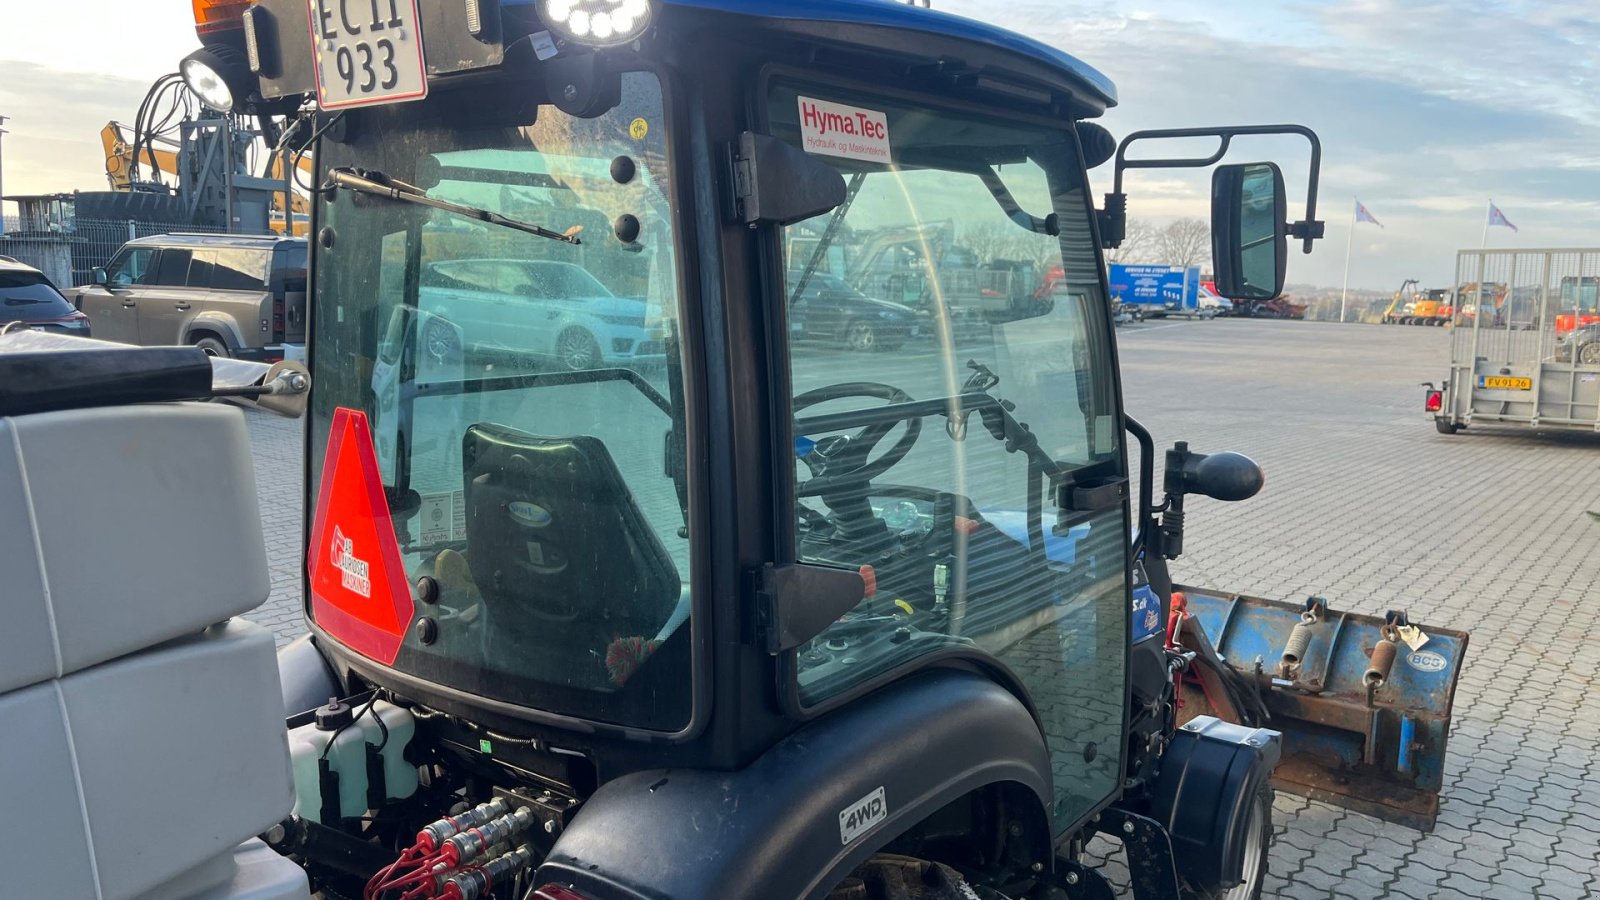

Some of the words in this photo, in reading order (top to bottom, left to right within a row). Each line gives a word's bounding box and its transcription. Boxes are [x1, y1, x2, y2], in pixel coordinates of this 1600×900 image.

[337, 39, 398, 95] 933
[802, 102, 884, 140] Hyma.Tec
[839, 143, 847, 153] og
[344, 539, 353, 556] AB
[1412, 654, 1440, 667] BCS
[846, 798, 881, 829] 4WD
